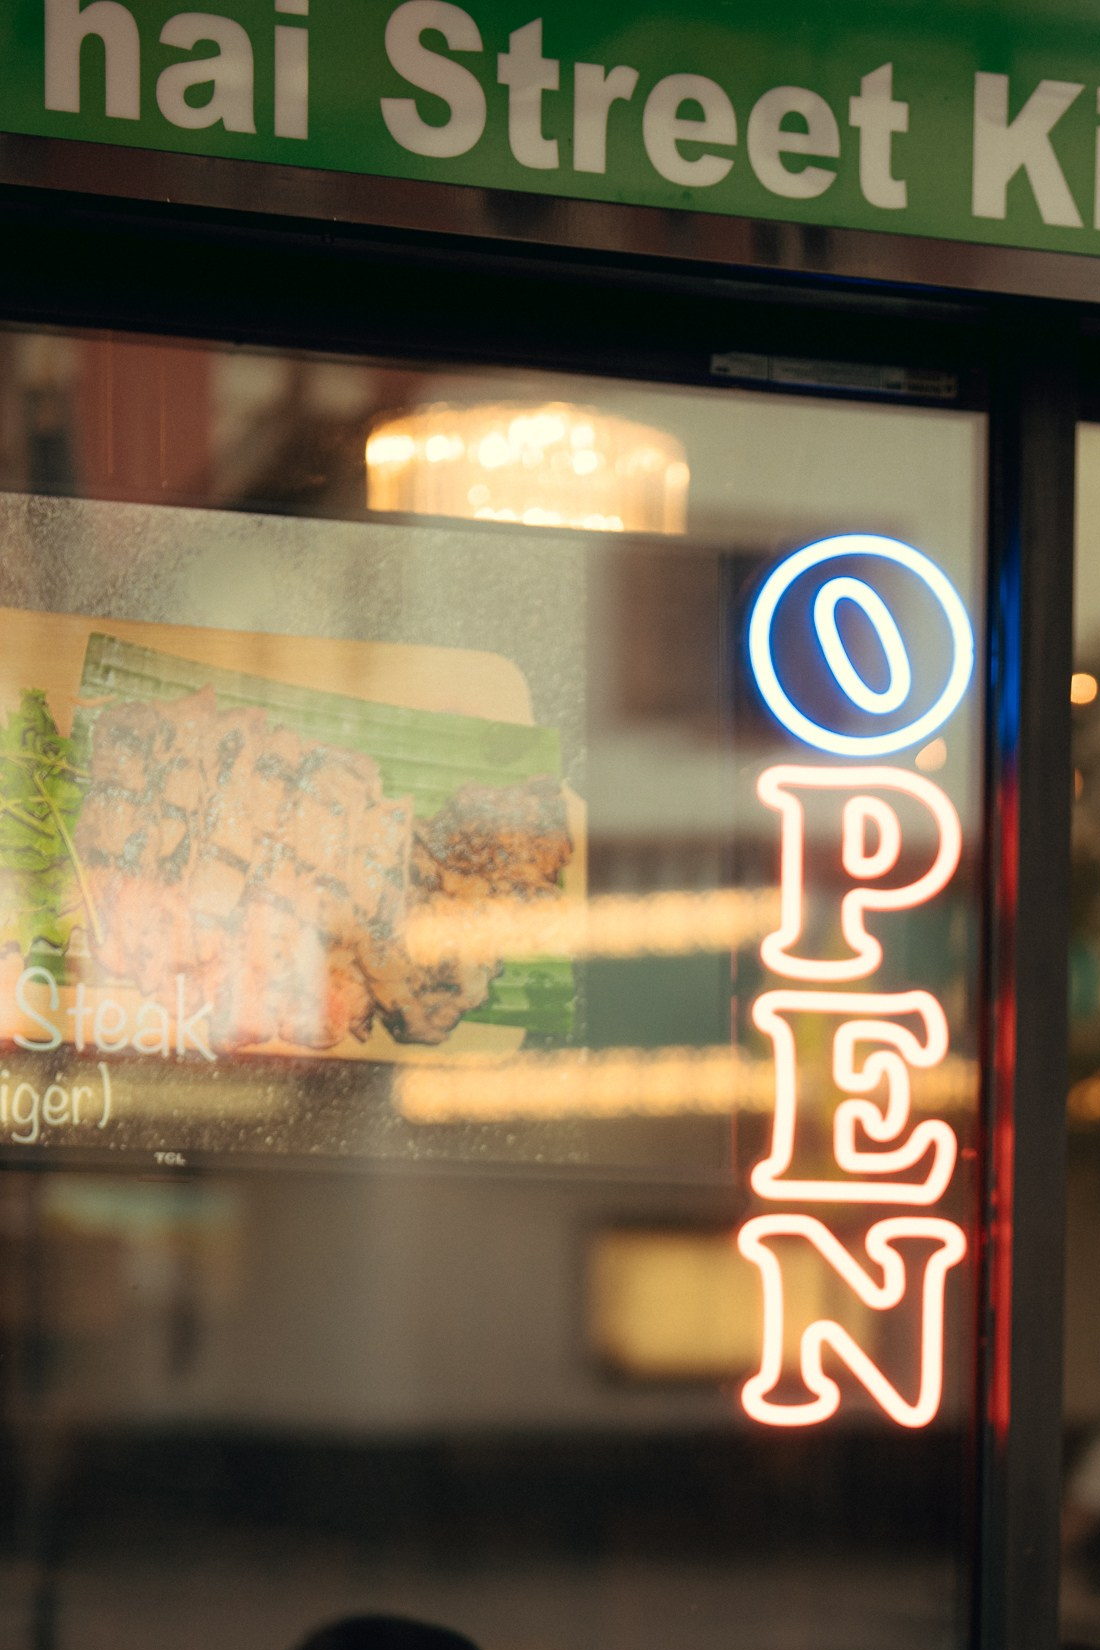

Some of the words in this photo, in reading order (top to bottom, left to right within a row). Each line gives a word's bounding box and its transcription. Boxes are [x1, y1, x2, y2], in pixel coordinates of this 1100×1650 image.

[380, 0, 908, 210] Street
[13, 965, 218, 1062] Steak
[737, 532, 975, 1430] OPEN
